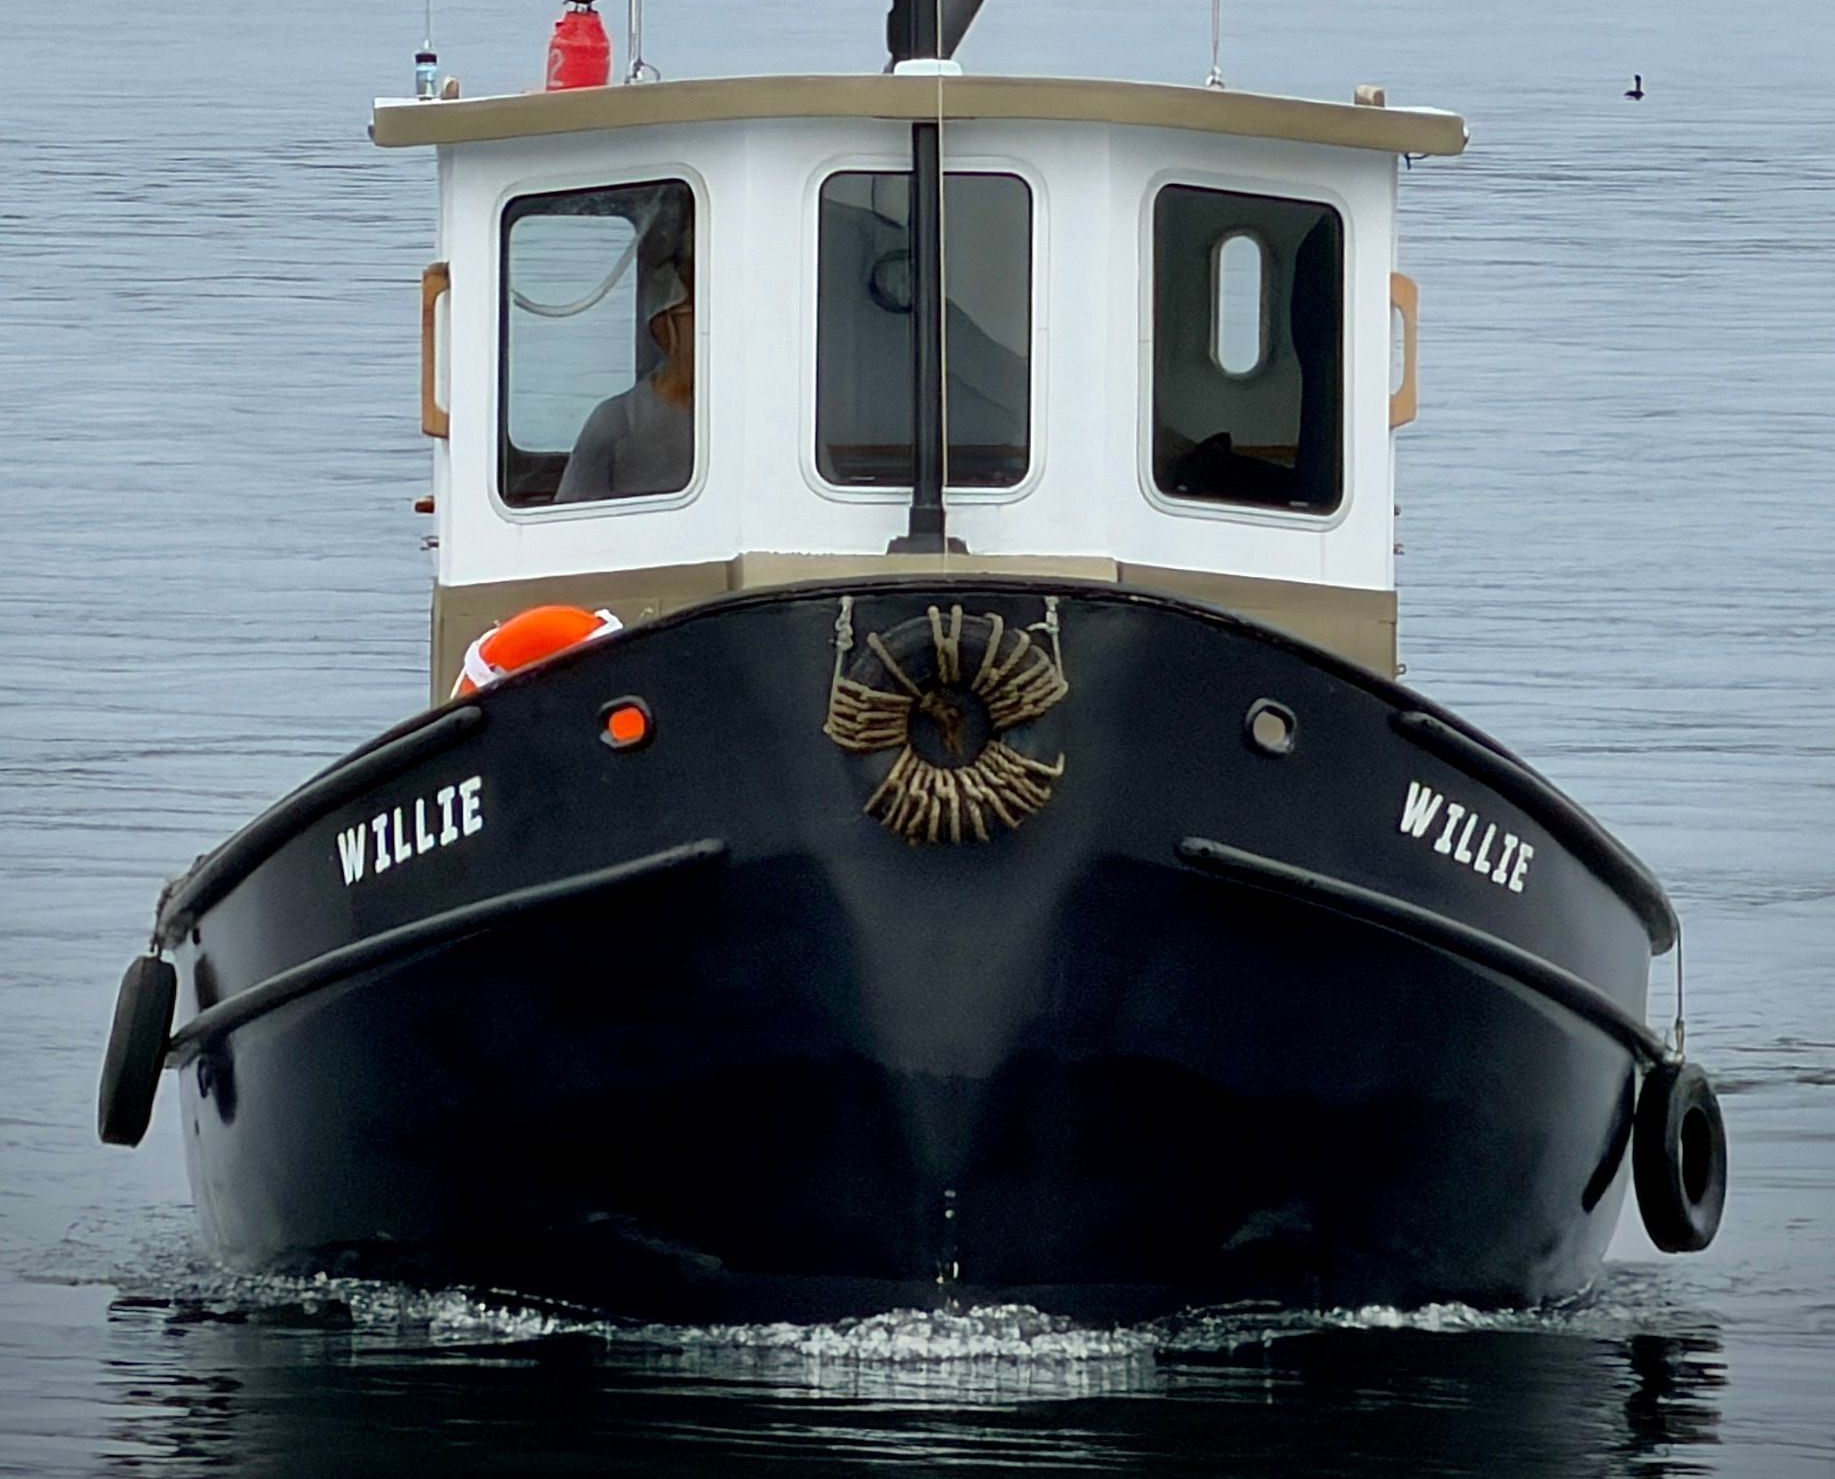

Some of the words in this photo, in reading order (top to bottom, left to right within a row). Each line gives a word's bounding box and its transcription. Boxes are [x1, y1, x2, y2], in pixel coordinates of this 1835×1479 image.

[550, 48, 564, 87] 2
[337, 775, 483, 887] WILLIE
[1400, 781, 1534, 893] WILLIE
